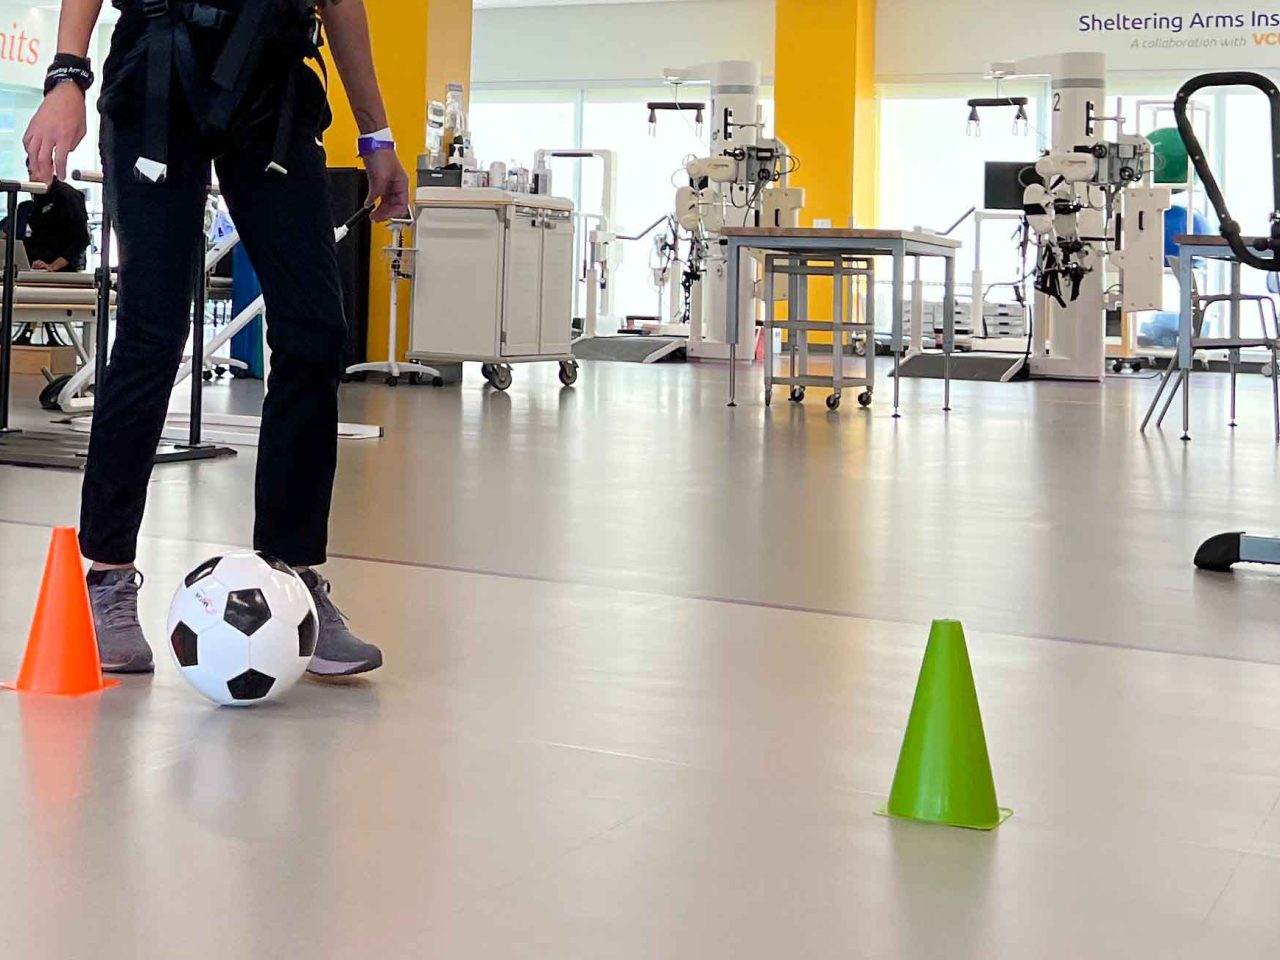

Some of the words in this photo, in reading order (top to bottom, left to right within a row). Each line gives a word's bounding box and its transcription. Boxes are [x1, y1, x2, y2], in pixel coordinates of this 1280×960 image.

[1079, 13, 1183, 32] Sheltering
[1189, 13, 1245, 29] Arms
[1130, 38, 1139, 49] A
[1142, 36, 1218, 49] collaboration
[1220, 36, 1247, 48] with
[1053, 92, 1061, 112] 2
